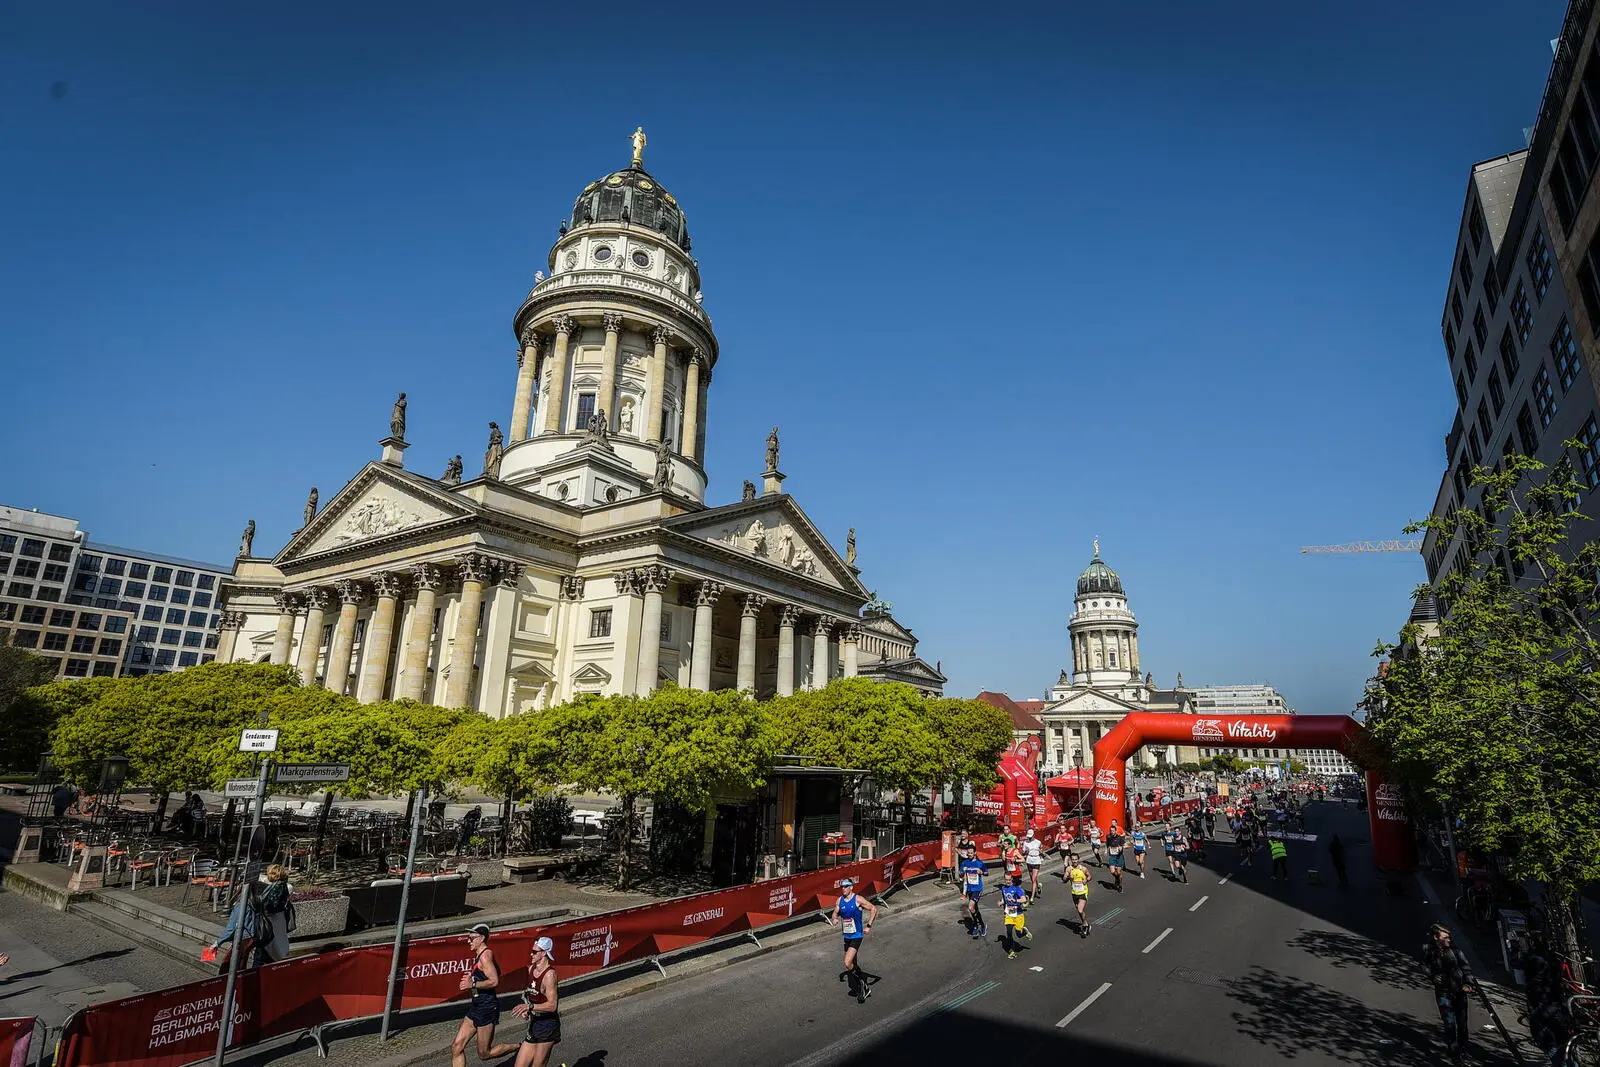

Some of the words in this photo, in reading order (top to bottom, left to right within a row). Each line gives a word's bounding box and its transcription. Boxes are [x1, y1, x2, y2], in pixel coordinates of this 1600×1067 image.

[1228, 720, 1276, 743] Vitality
[279, 766, 344, 779] Markgrafenstraße
[1095, 789, 1119, 804] Vitality
[1377, 808, 1408, 824] Vitality
[693, 907, 724, 924] GENERALI
[580, 926, 608, 939] GENERALI
[569, 941, 619, 960] HALBMARATON
[571, 937, 601, 950] BERLINER
[173, 995, 225, 1016] GENERAL
[148, 1011, 252, 1049] HALBMARAON
[151, 1010, 214, 1036] BERLINER
